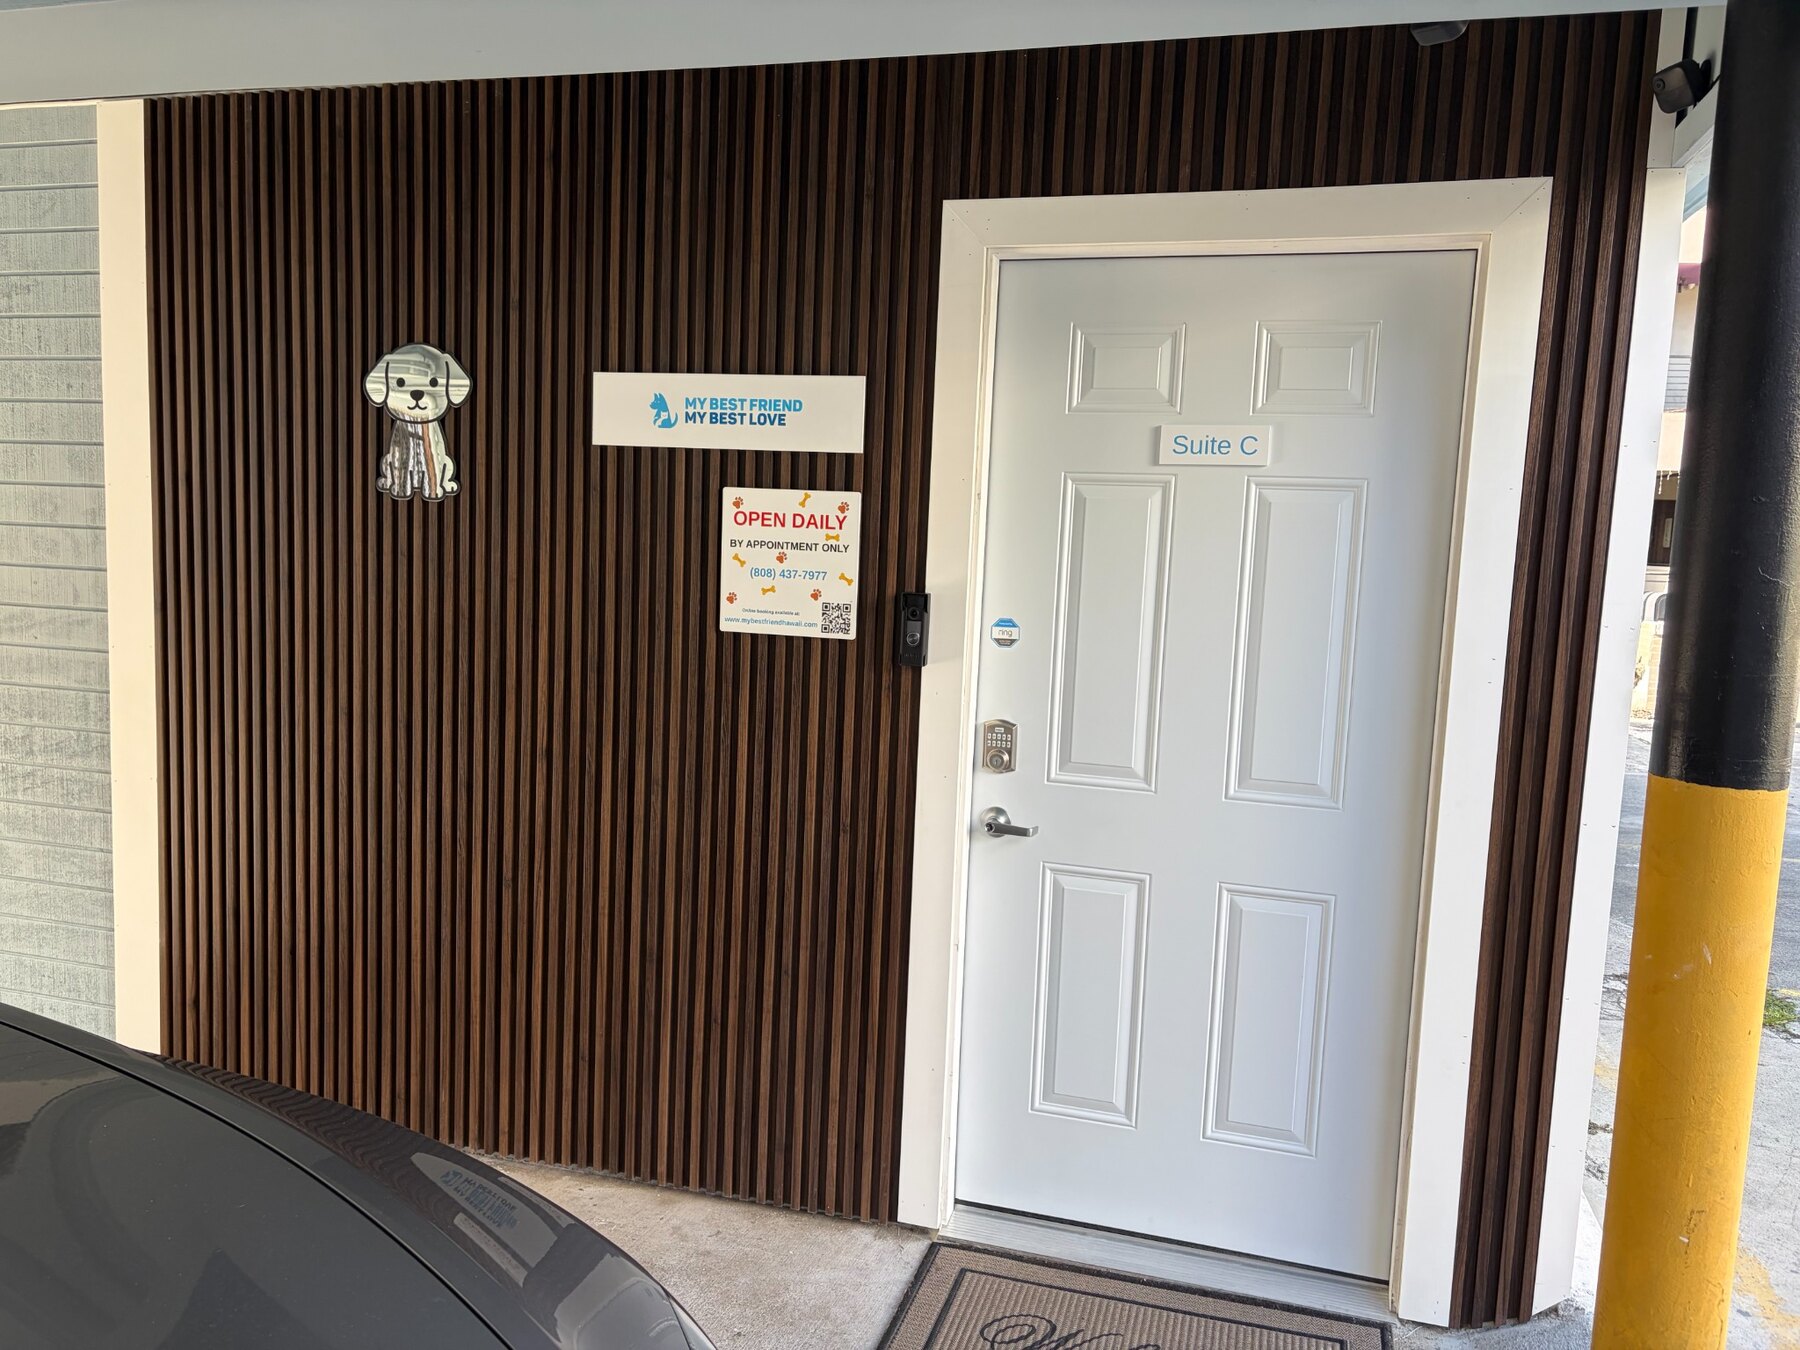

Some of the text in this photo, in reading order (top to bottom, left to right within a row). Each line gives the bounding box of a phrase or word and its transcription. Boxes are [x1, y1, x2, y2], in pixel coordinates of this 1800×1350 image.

[685, 397, 803, 412] MY BEST FRIEND
[685, 411, 786, 426] MY BEST LOVE
[1172, 435, 1258, 455] Suite C
[734, 511, 847, 530] OPEN DAILY
[730, 539, 850, 553] BY APPOINTMENT ONLY
[750, 567, 827, 581] (808) 437-7977
[998, 629, 1013, 638] ring
